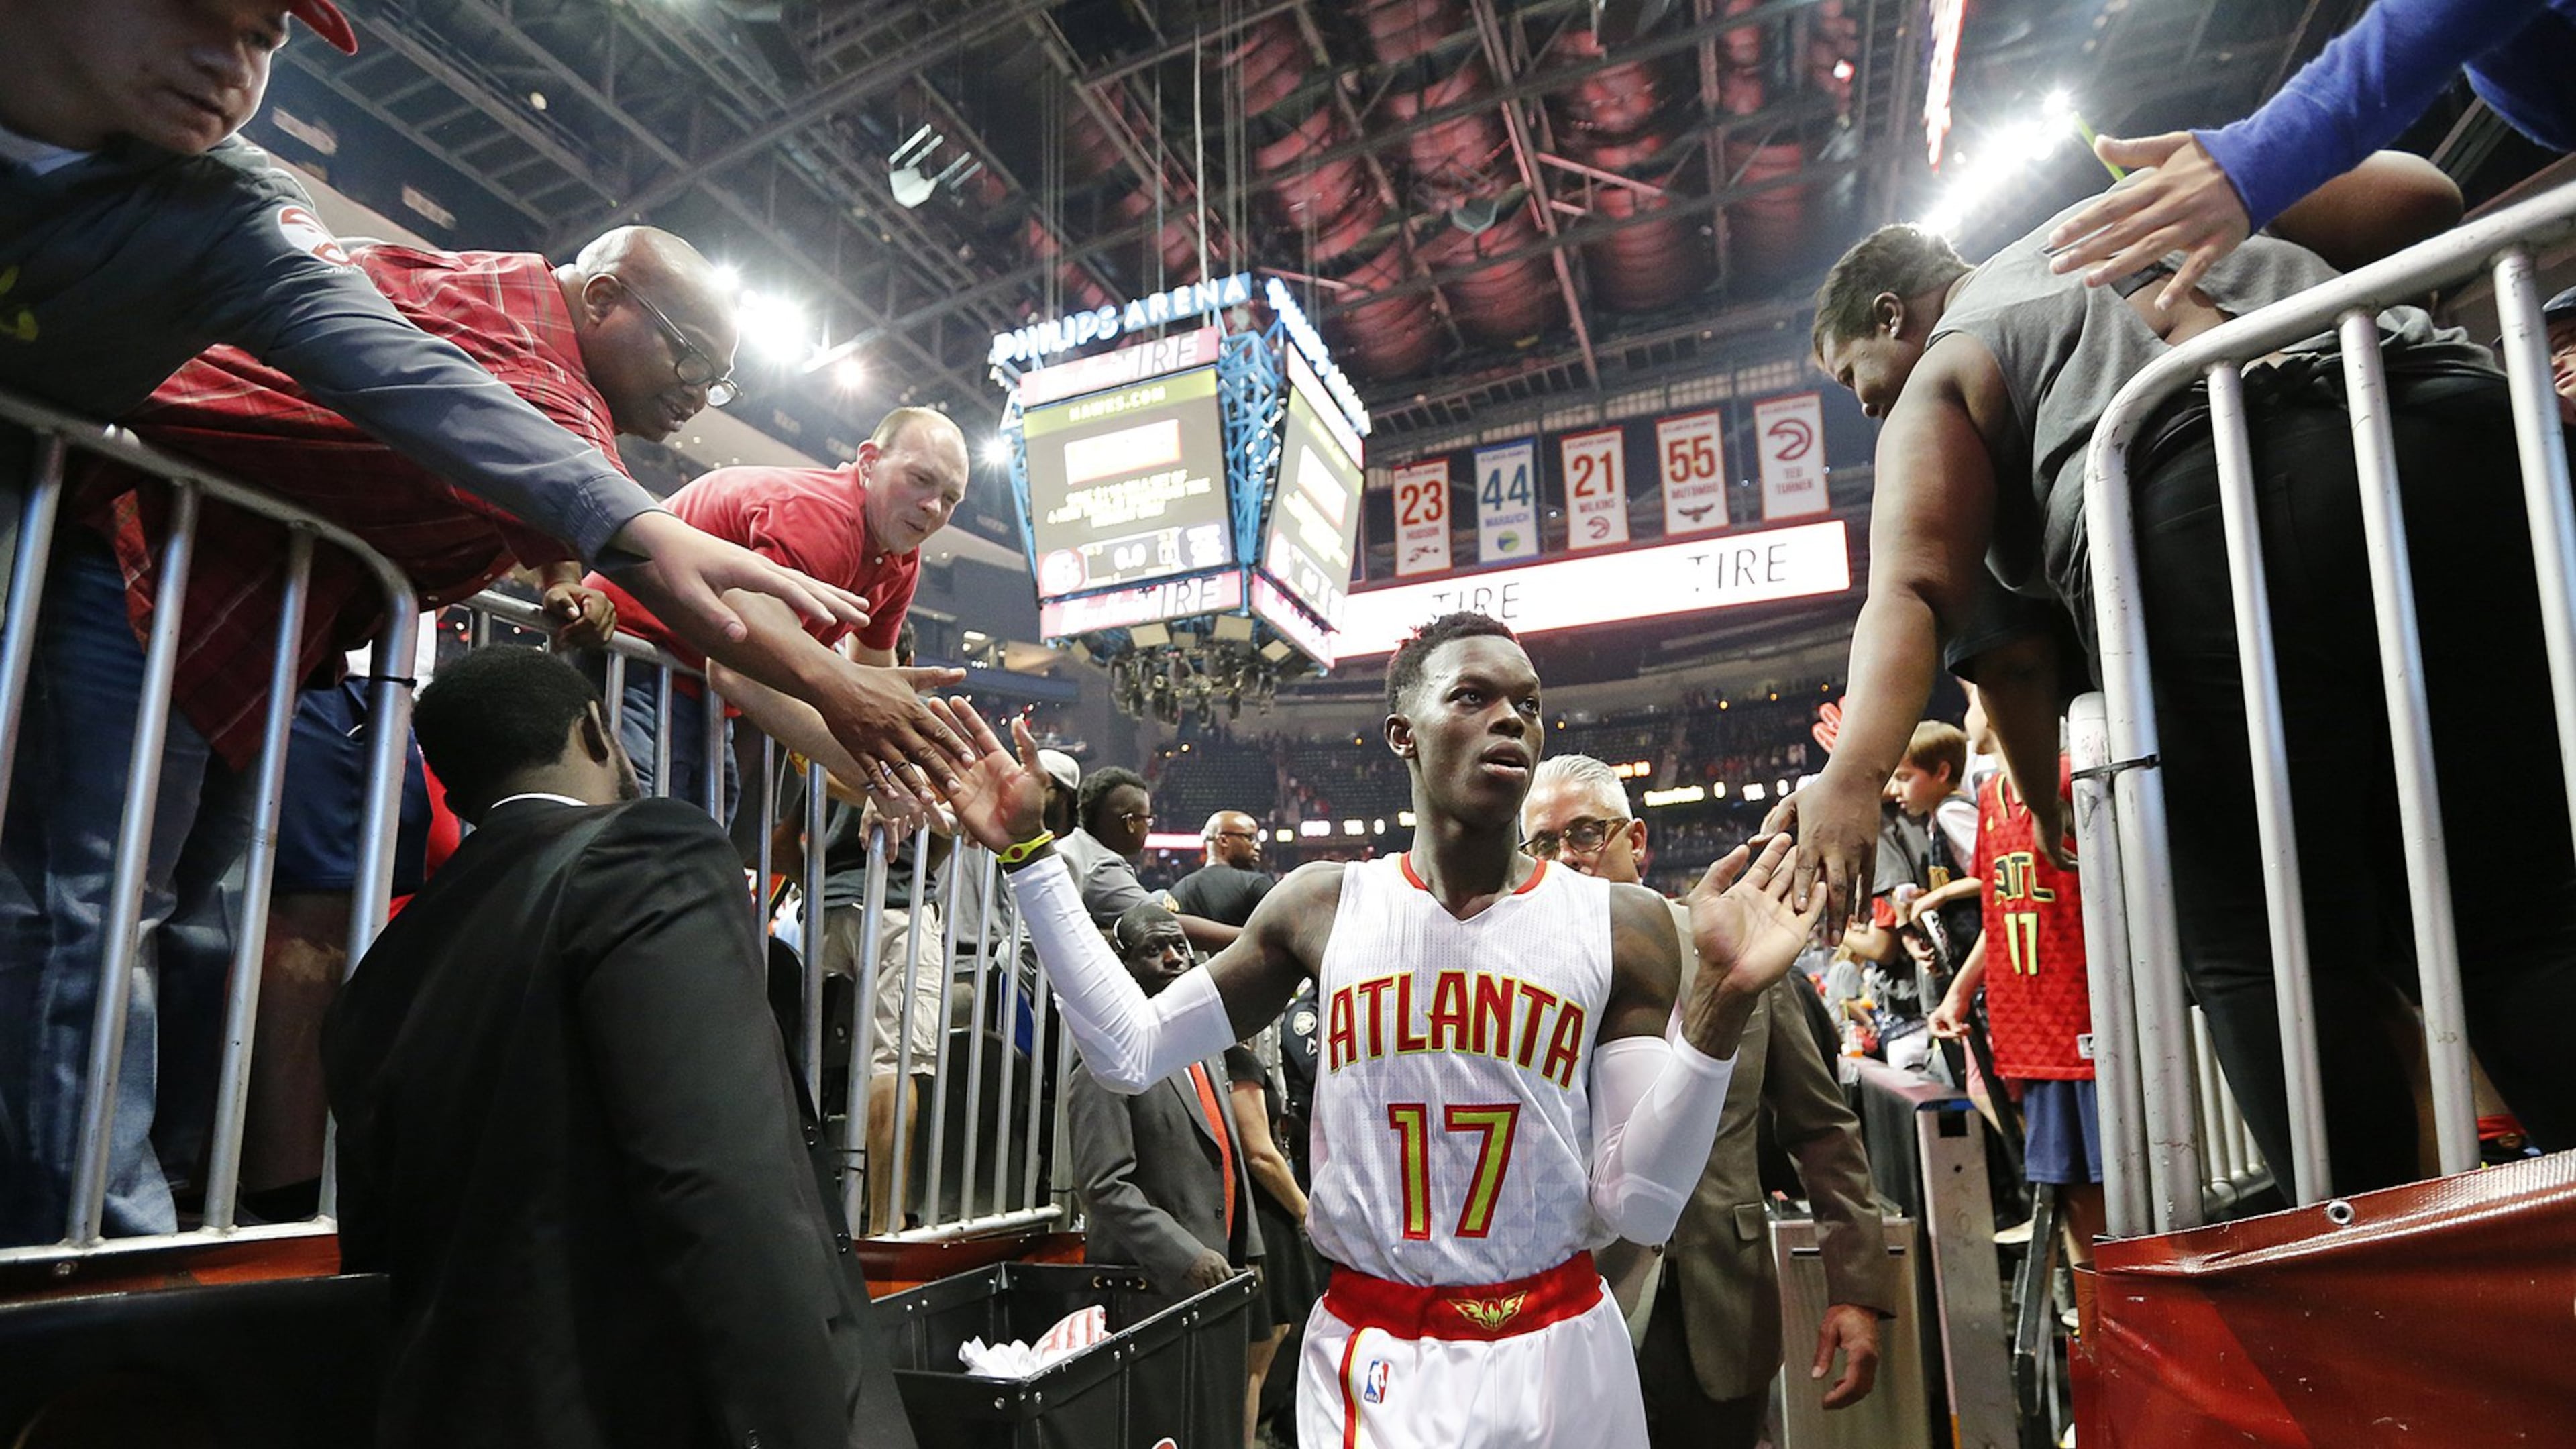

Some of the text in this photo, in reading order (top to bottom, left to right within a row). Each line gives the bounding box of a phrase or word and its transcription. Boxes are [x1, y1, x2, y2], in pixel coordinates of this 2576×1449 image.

[994, 274, 1246, 364] PHILIPS ARENA
[1573, 450, 1614, 497] 21
[1669, 435, 1716, 483] 55
[1401, 480, 1442, 526] 23
[1481, 463, 1531, 511] 44
[1994, 851, 2055, 906] ATL
[1328, 971, 1585, 1091] ATLANTA
[1387, 1102, 1521, 1241] 17
